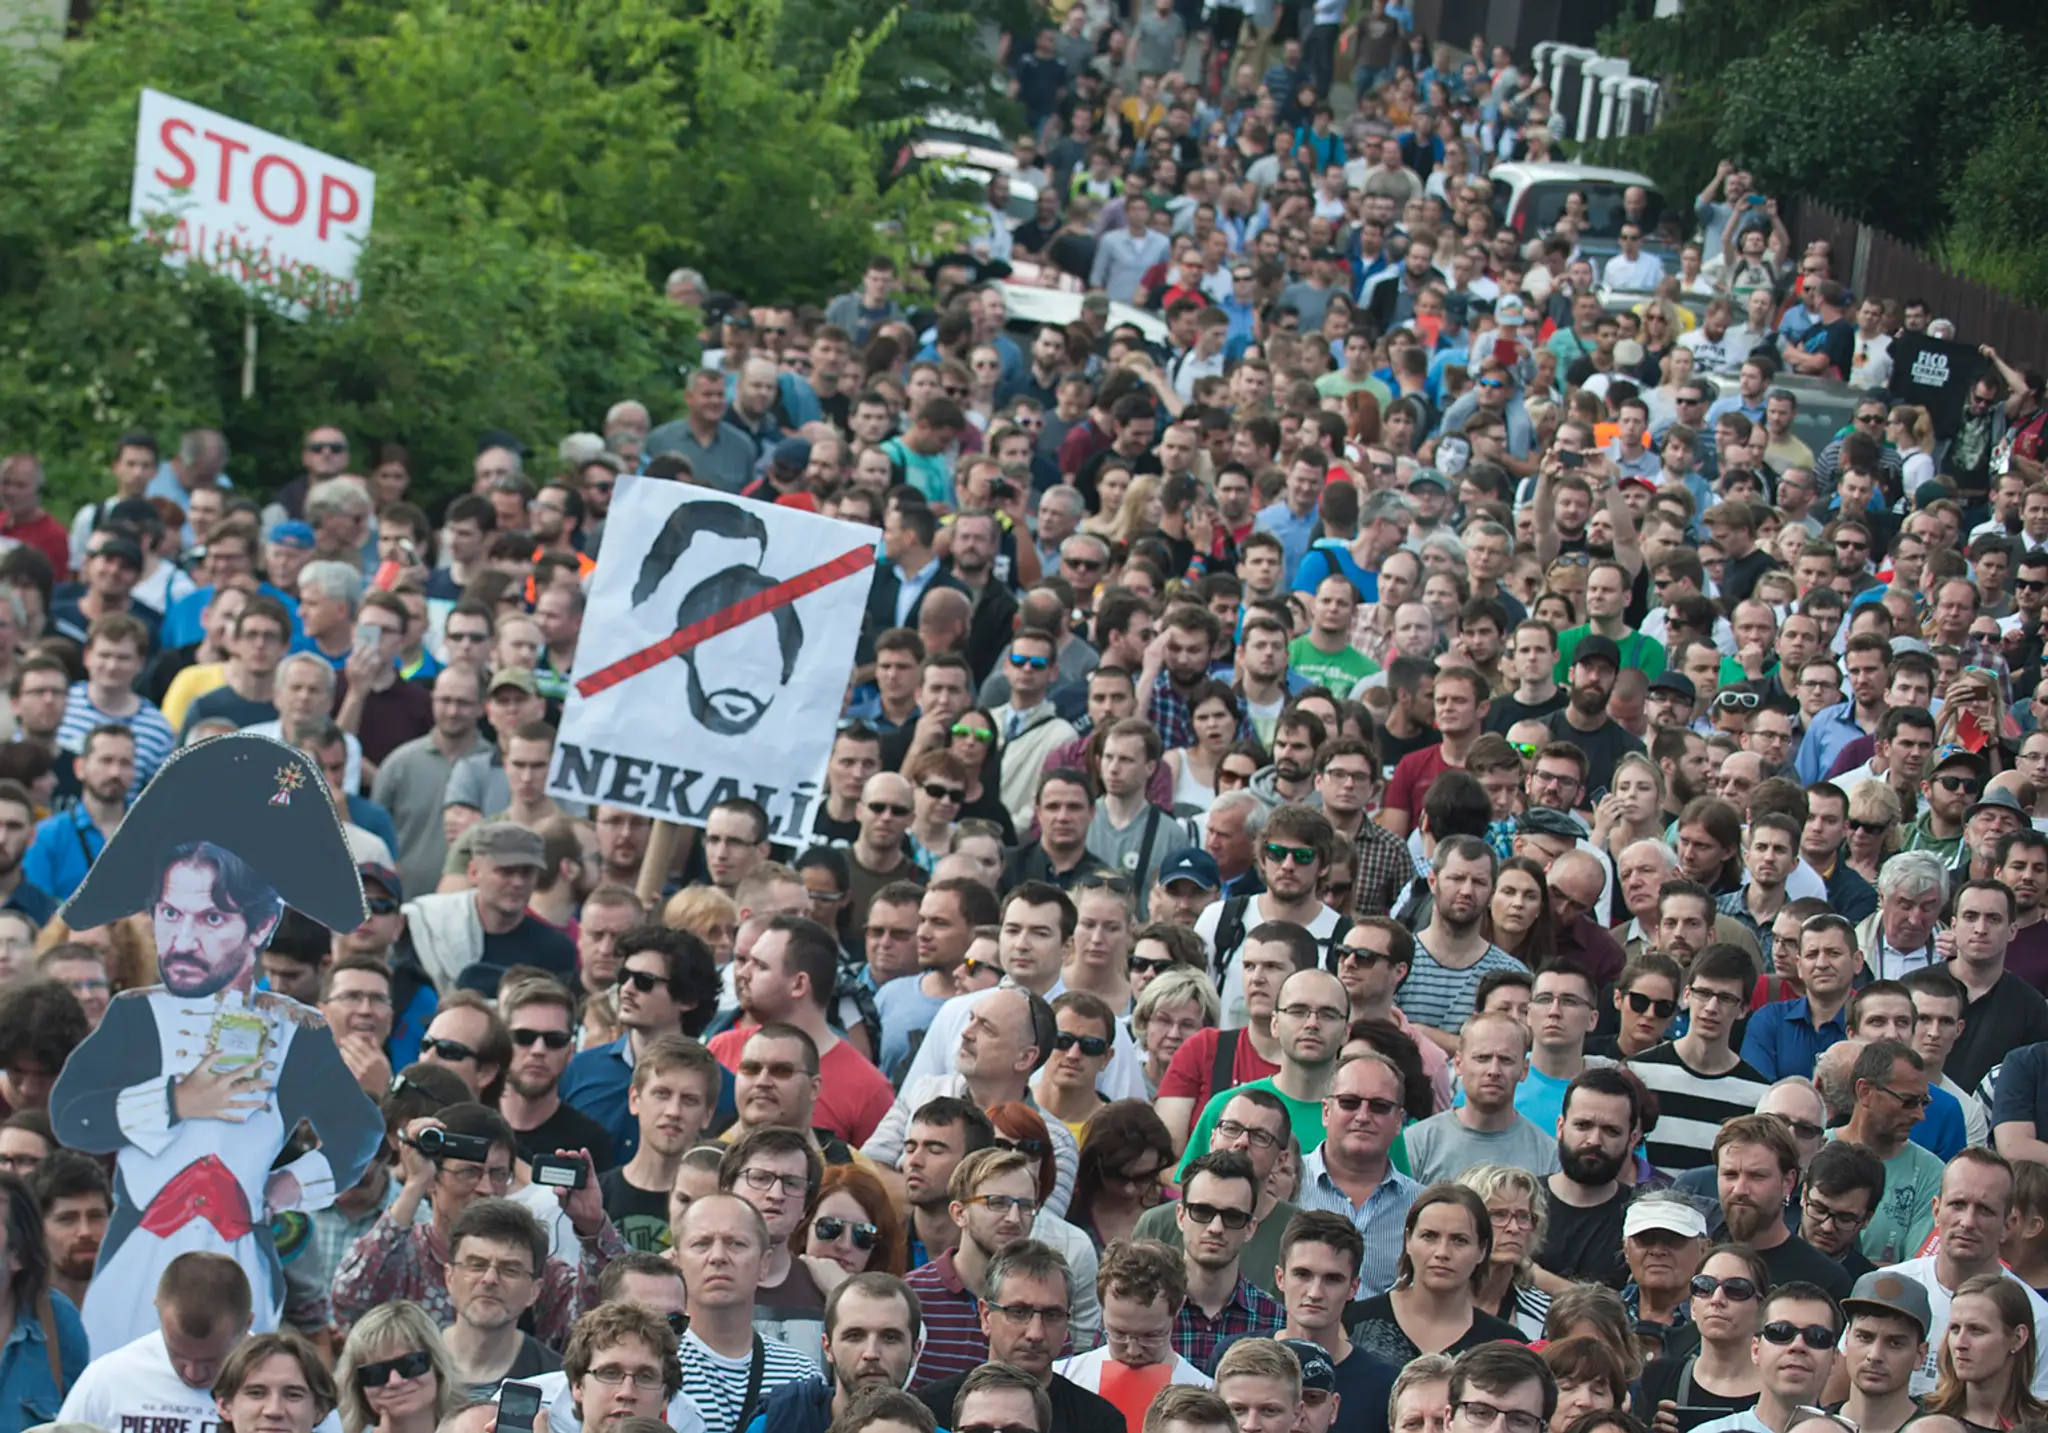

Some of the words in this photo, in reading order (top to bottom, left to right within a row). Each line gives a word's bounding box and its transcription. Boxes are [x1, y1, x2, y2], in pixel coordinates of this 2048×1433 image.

[155, 118, 359, 240] STOP
[1918, 351, 1948, 369] FICO
[551, 743, 817, 838] NEKALÍ
[121, 1415, 191, 1433] PIERRE
